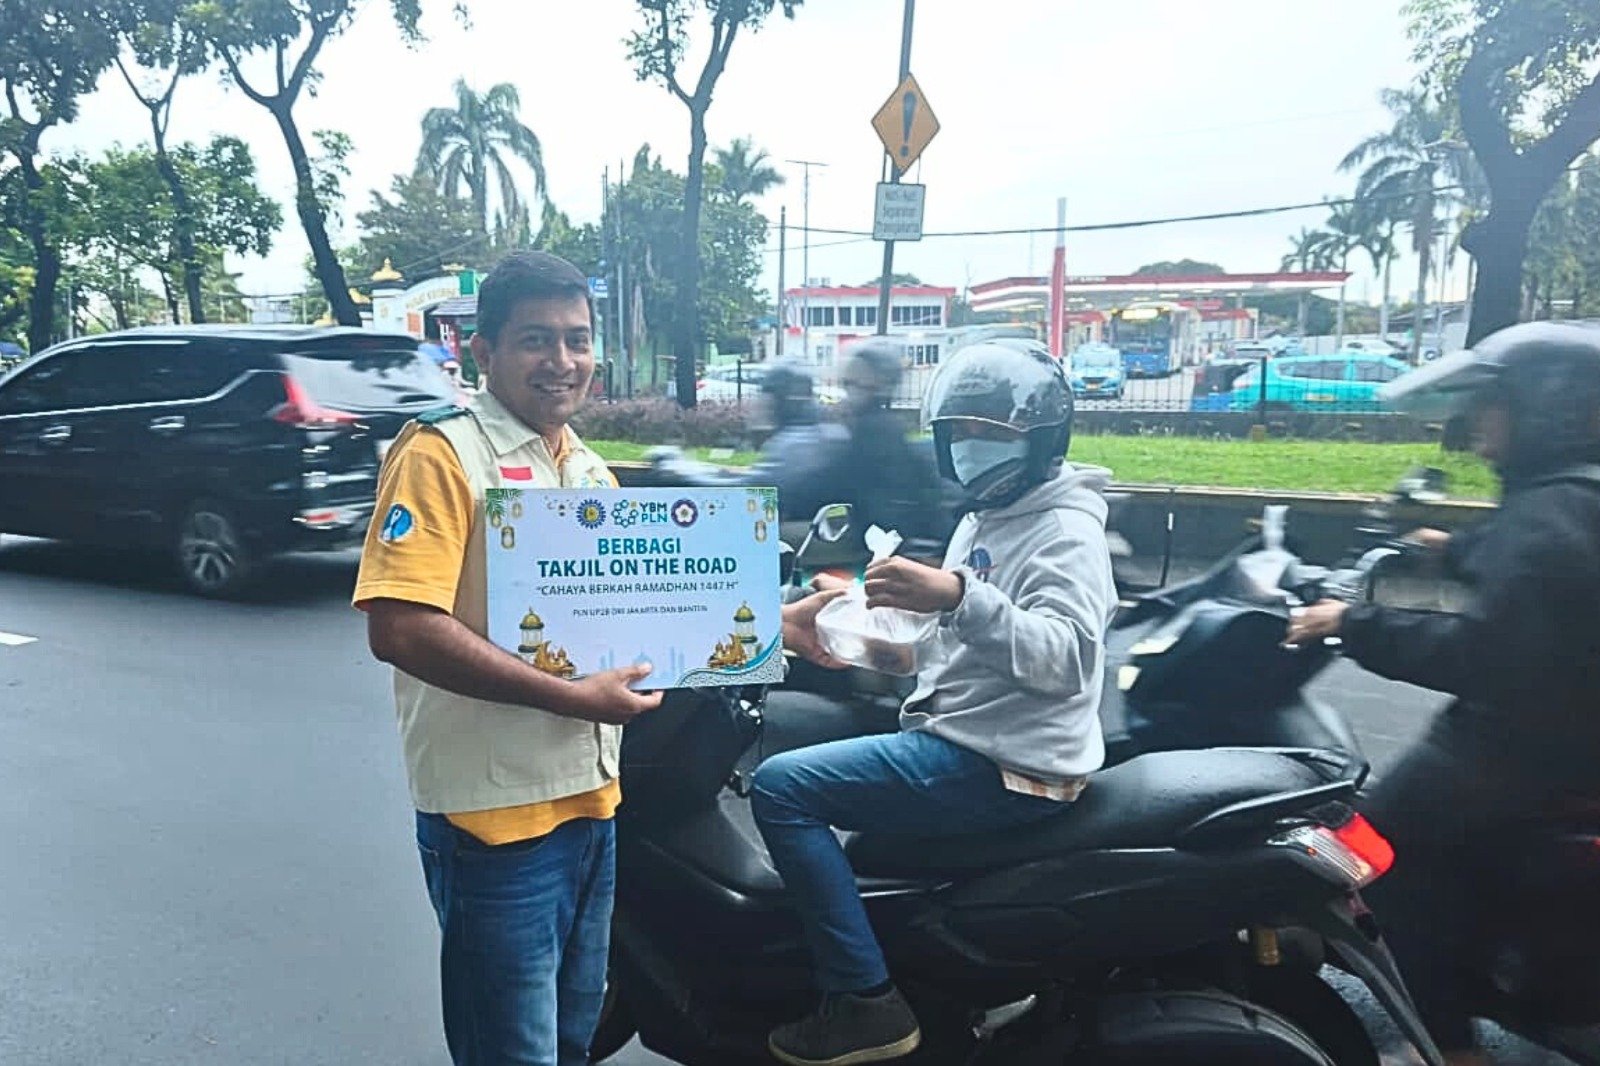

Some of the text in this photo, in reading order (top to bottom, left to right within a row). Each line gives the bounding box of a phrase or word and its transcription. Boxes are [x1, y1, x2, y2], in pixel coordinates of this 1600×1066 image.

[639, 502, 668, 513] YBM
[641, 513, 668, 523] PLN
[597, 537, 682, 556] BERBAGI
[537, 556, 738, 578] TAKJIL ON THE ROAD
[589, 582, 633, 595] BERKAH
[634, 581, 698, 593] RAMADHAN
[573, 608, 588, 616] PLN
[678, 604, 708, 613] BANTEN
